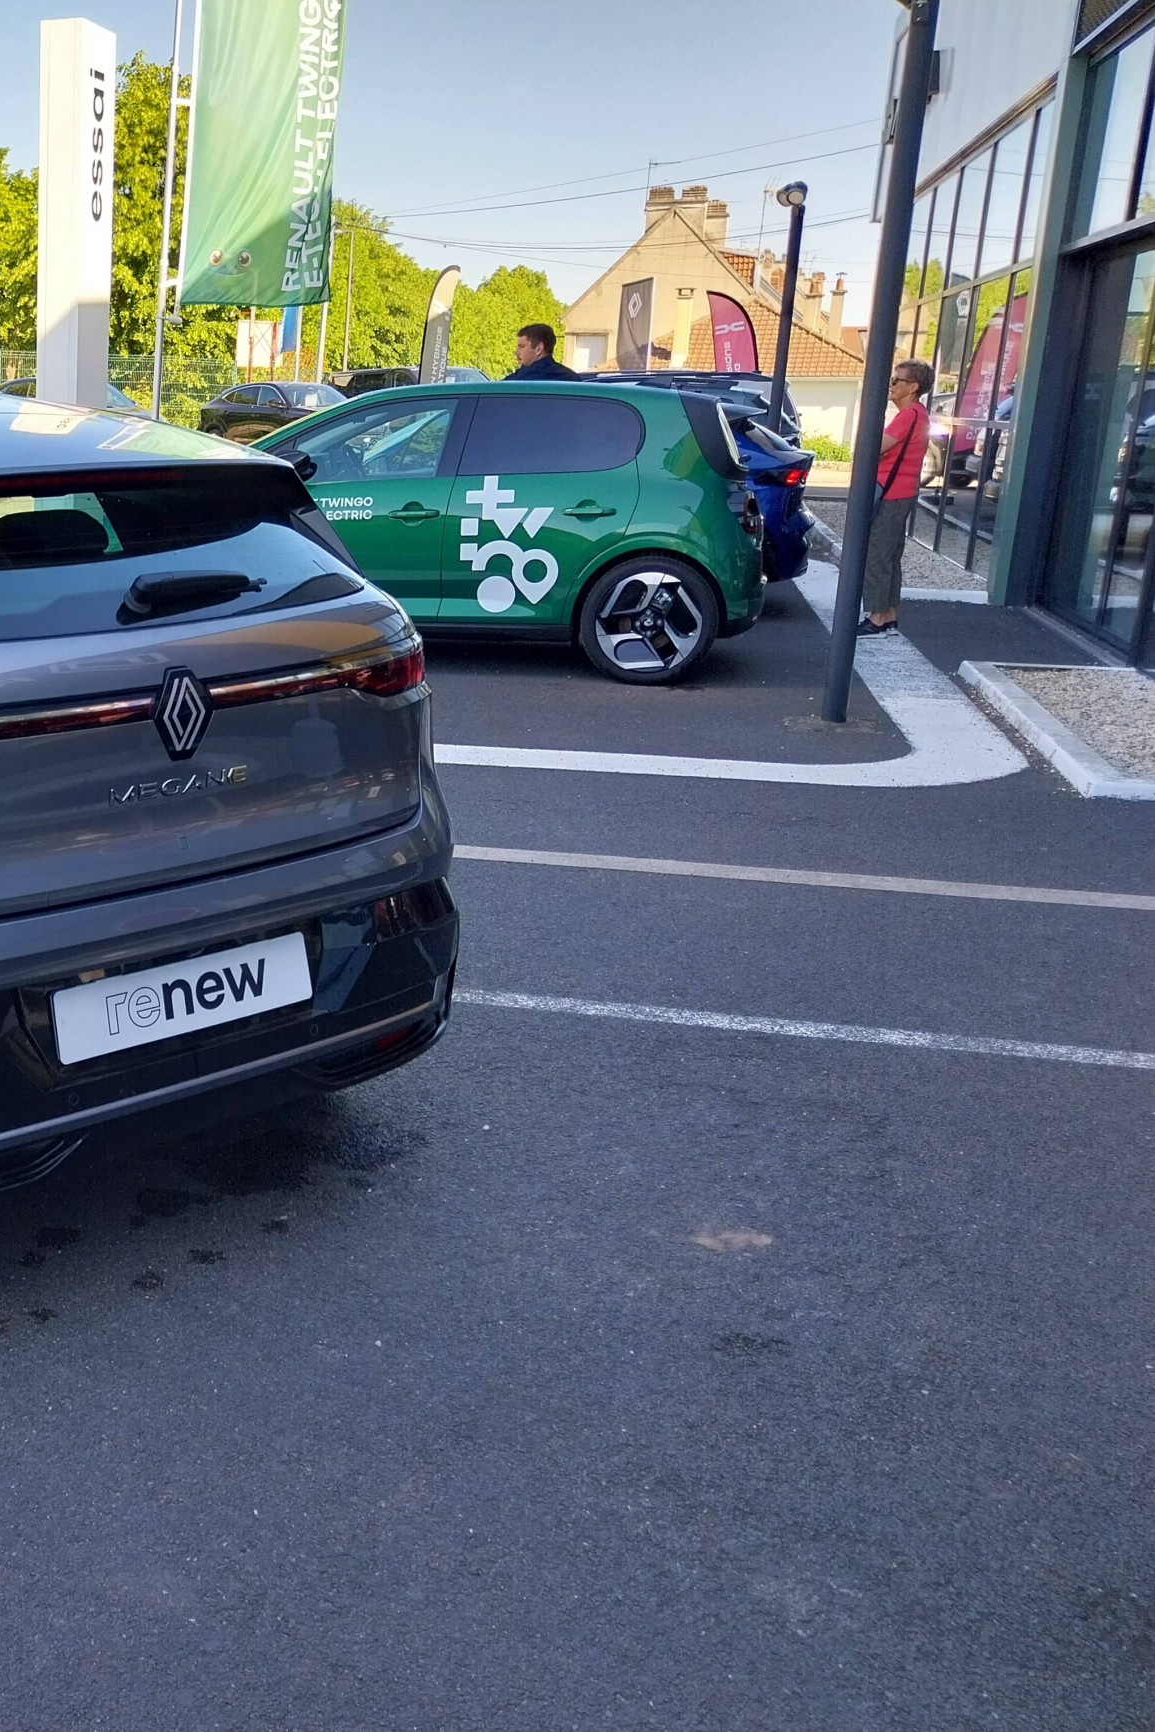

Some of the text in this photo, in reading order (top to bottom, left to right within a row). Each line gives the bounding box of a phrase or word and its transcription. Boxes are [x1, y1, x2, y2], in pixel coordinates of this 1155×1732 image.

[89, 67, 105, 222] essai
[281, 128, 315, 292] RENAULT
[430, 326, 443, 375] HYBRIDE
[320, 496, 373, 508] TWINGO
[326, 509, 373, 521] ECTRIC
[109, 765, 247, 806] MEGANE
[105, 957, 266, 1036] renew
